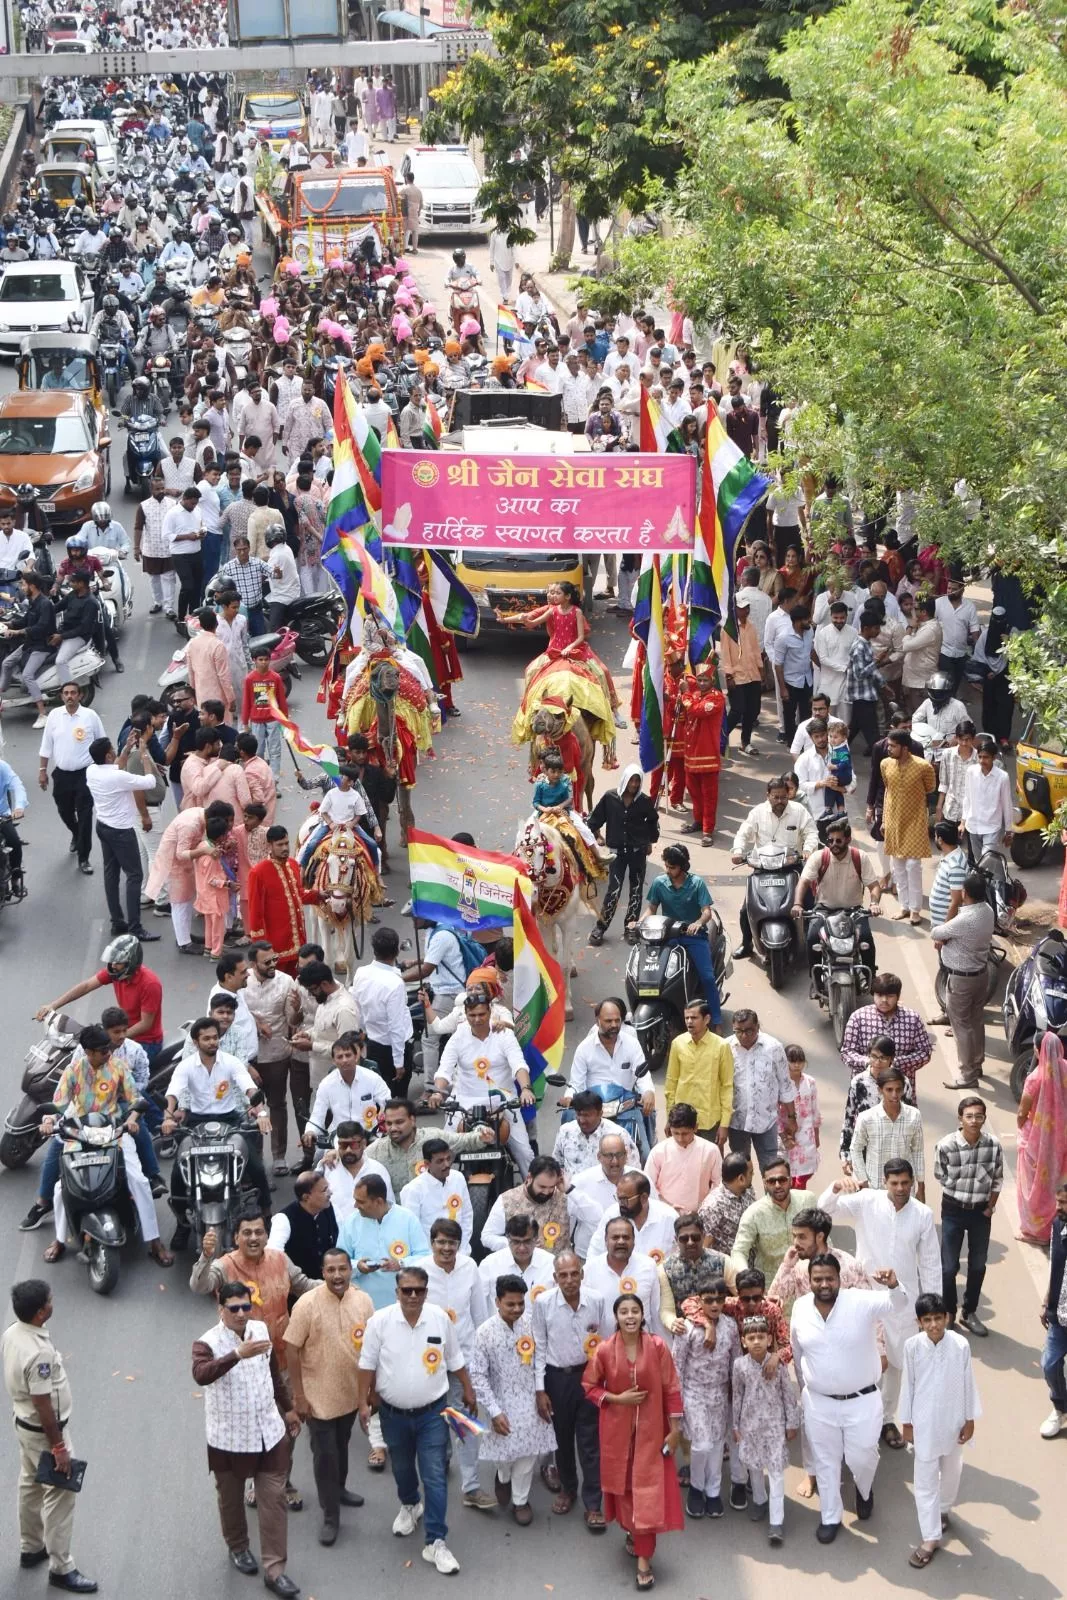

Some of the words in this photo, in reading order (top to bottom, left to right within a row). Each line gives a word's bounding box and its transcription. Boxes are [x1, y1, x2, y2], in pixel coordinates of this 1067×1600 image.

[448, 459, 480, 487] श्री
[487, 459, 539, 487] जैन
[548, 460, 606, 488] सेवा
[614, 459, 664, 488] संघ
[496, 497, 543, 515] आप
[551, 497, 581, 515] का
[422, 517, 487, 541] हार्दिक
[496, 525, 565, 544] स्वागत
[574, 526, 632, 543] करता
[639, 519, 655, 546] है
